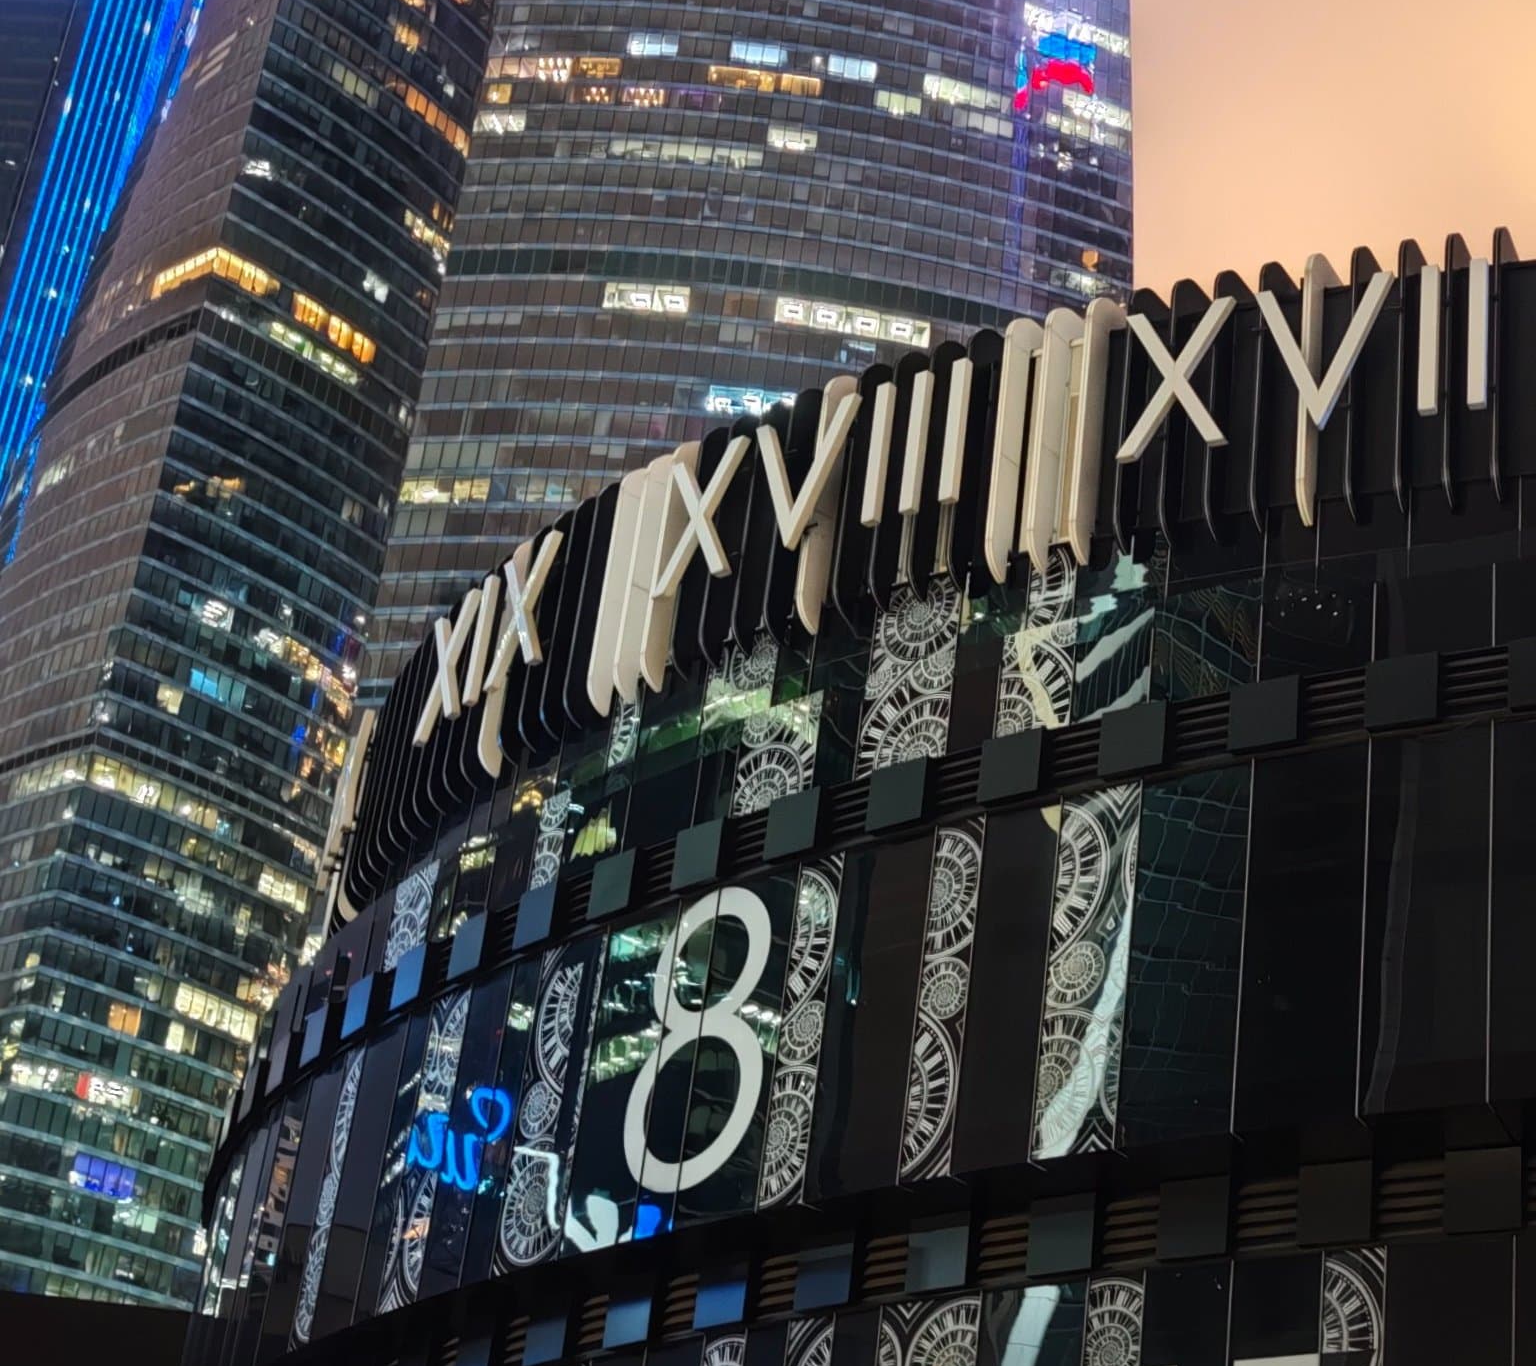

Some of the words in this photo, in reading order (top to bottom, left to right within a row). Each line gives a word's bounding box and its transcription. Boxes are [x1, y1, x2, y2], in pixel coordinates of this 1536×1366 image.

[1115, 258, 1489, 465] XVII
[651, 357, 971, 599] XVIII
[413, 530, 564, 747] XIX
